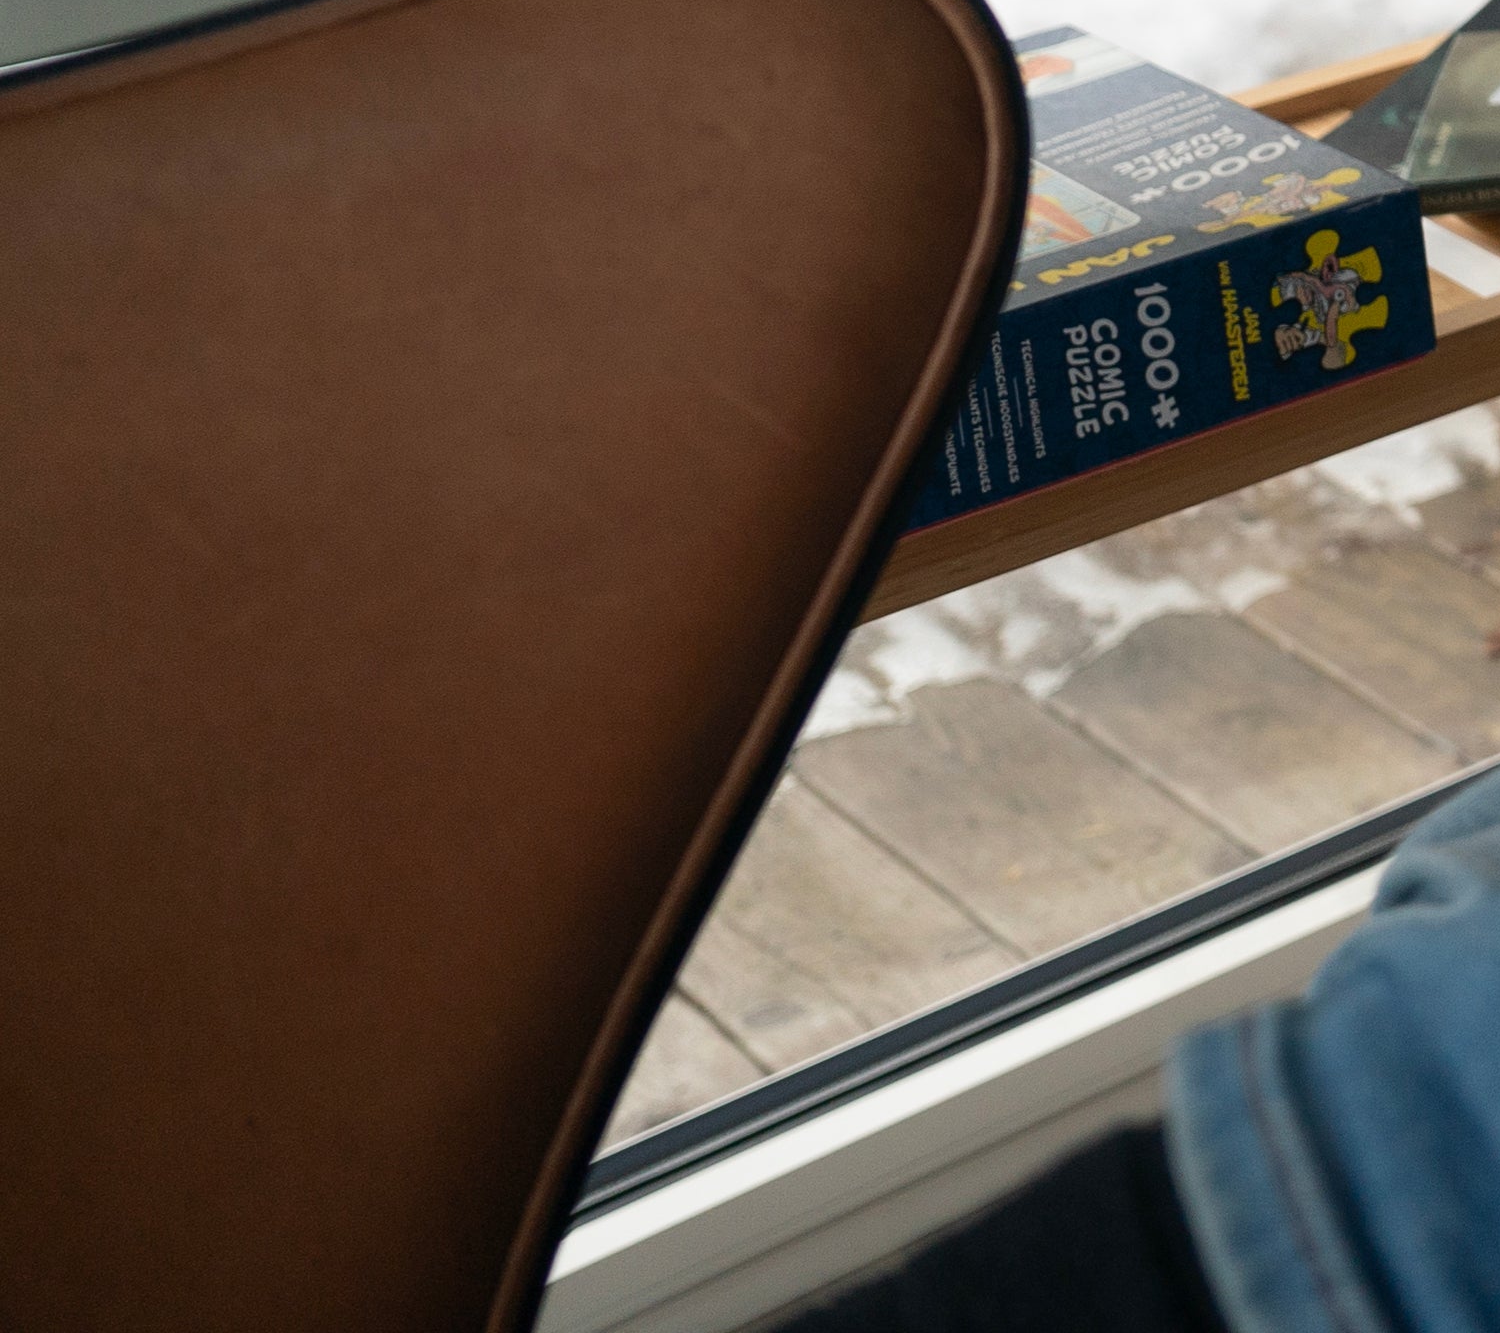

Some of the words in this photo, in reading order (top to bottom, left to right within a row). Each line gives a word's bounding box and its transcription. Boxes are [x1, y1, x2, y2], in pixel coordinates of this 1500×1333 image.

[1112, 124, 1235, 176] PUZZLE
[1130, 133, 1247, 182] COMIC
[1171, 134, 1301, 192] 1000
[1037, 234, 1176, 285] JAN
[1218, 260, 1232, 286] VAN
[1134, 282, 1180, 391] 1000
[1221, 289, 1251, 401] HAASTEREN
[1243, 307, 1261, 344] JAN
[991, 330, 1009, 397] TECHNISCHE
[1063, 324, 1101, 439] PUZZLE
[1090, 317, 1130, 426] COMIC
[1020, 338, 1038, 398] TECHNICAL
[1029, 397, 1047, 460] HIGHLIGHTS
[972, 426, 993, 494] TECHNIQUES
[999, 398, 1021, 485] HOOGSTANDJES
